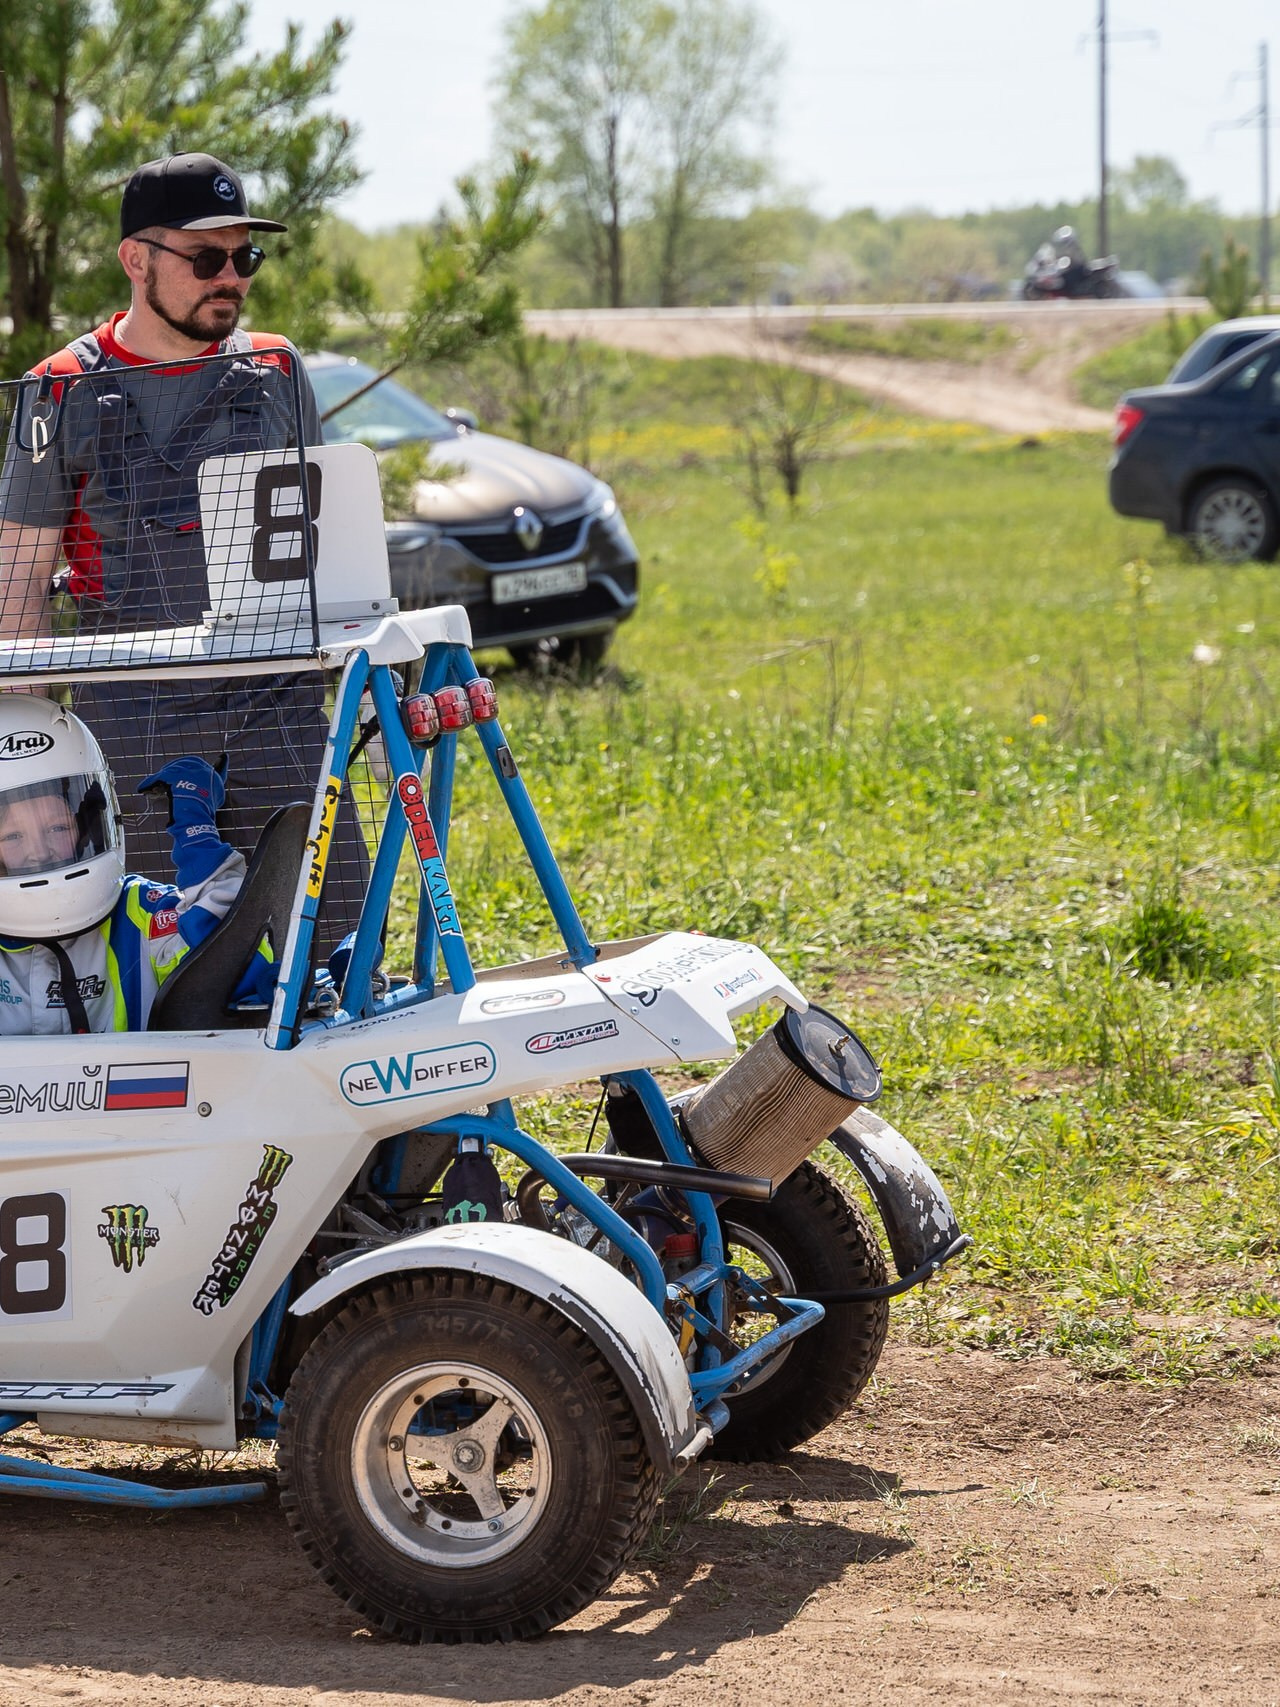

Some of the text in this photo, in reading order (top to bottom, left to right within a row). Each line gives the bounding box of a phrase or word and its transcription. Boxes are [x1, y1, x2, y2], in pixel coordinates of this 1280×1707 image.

[252, 462, 322, 584] 8
[350, 1010, 417, 1031] HONDA
[0, 1192, 66, 1315] 8
[221, 1205, 274, 1305] ENERGY
